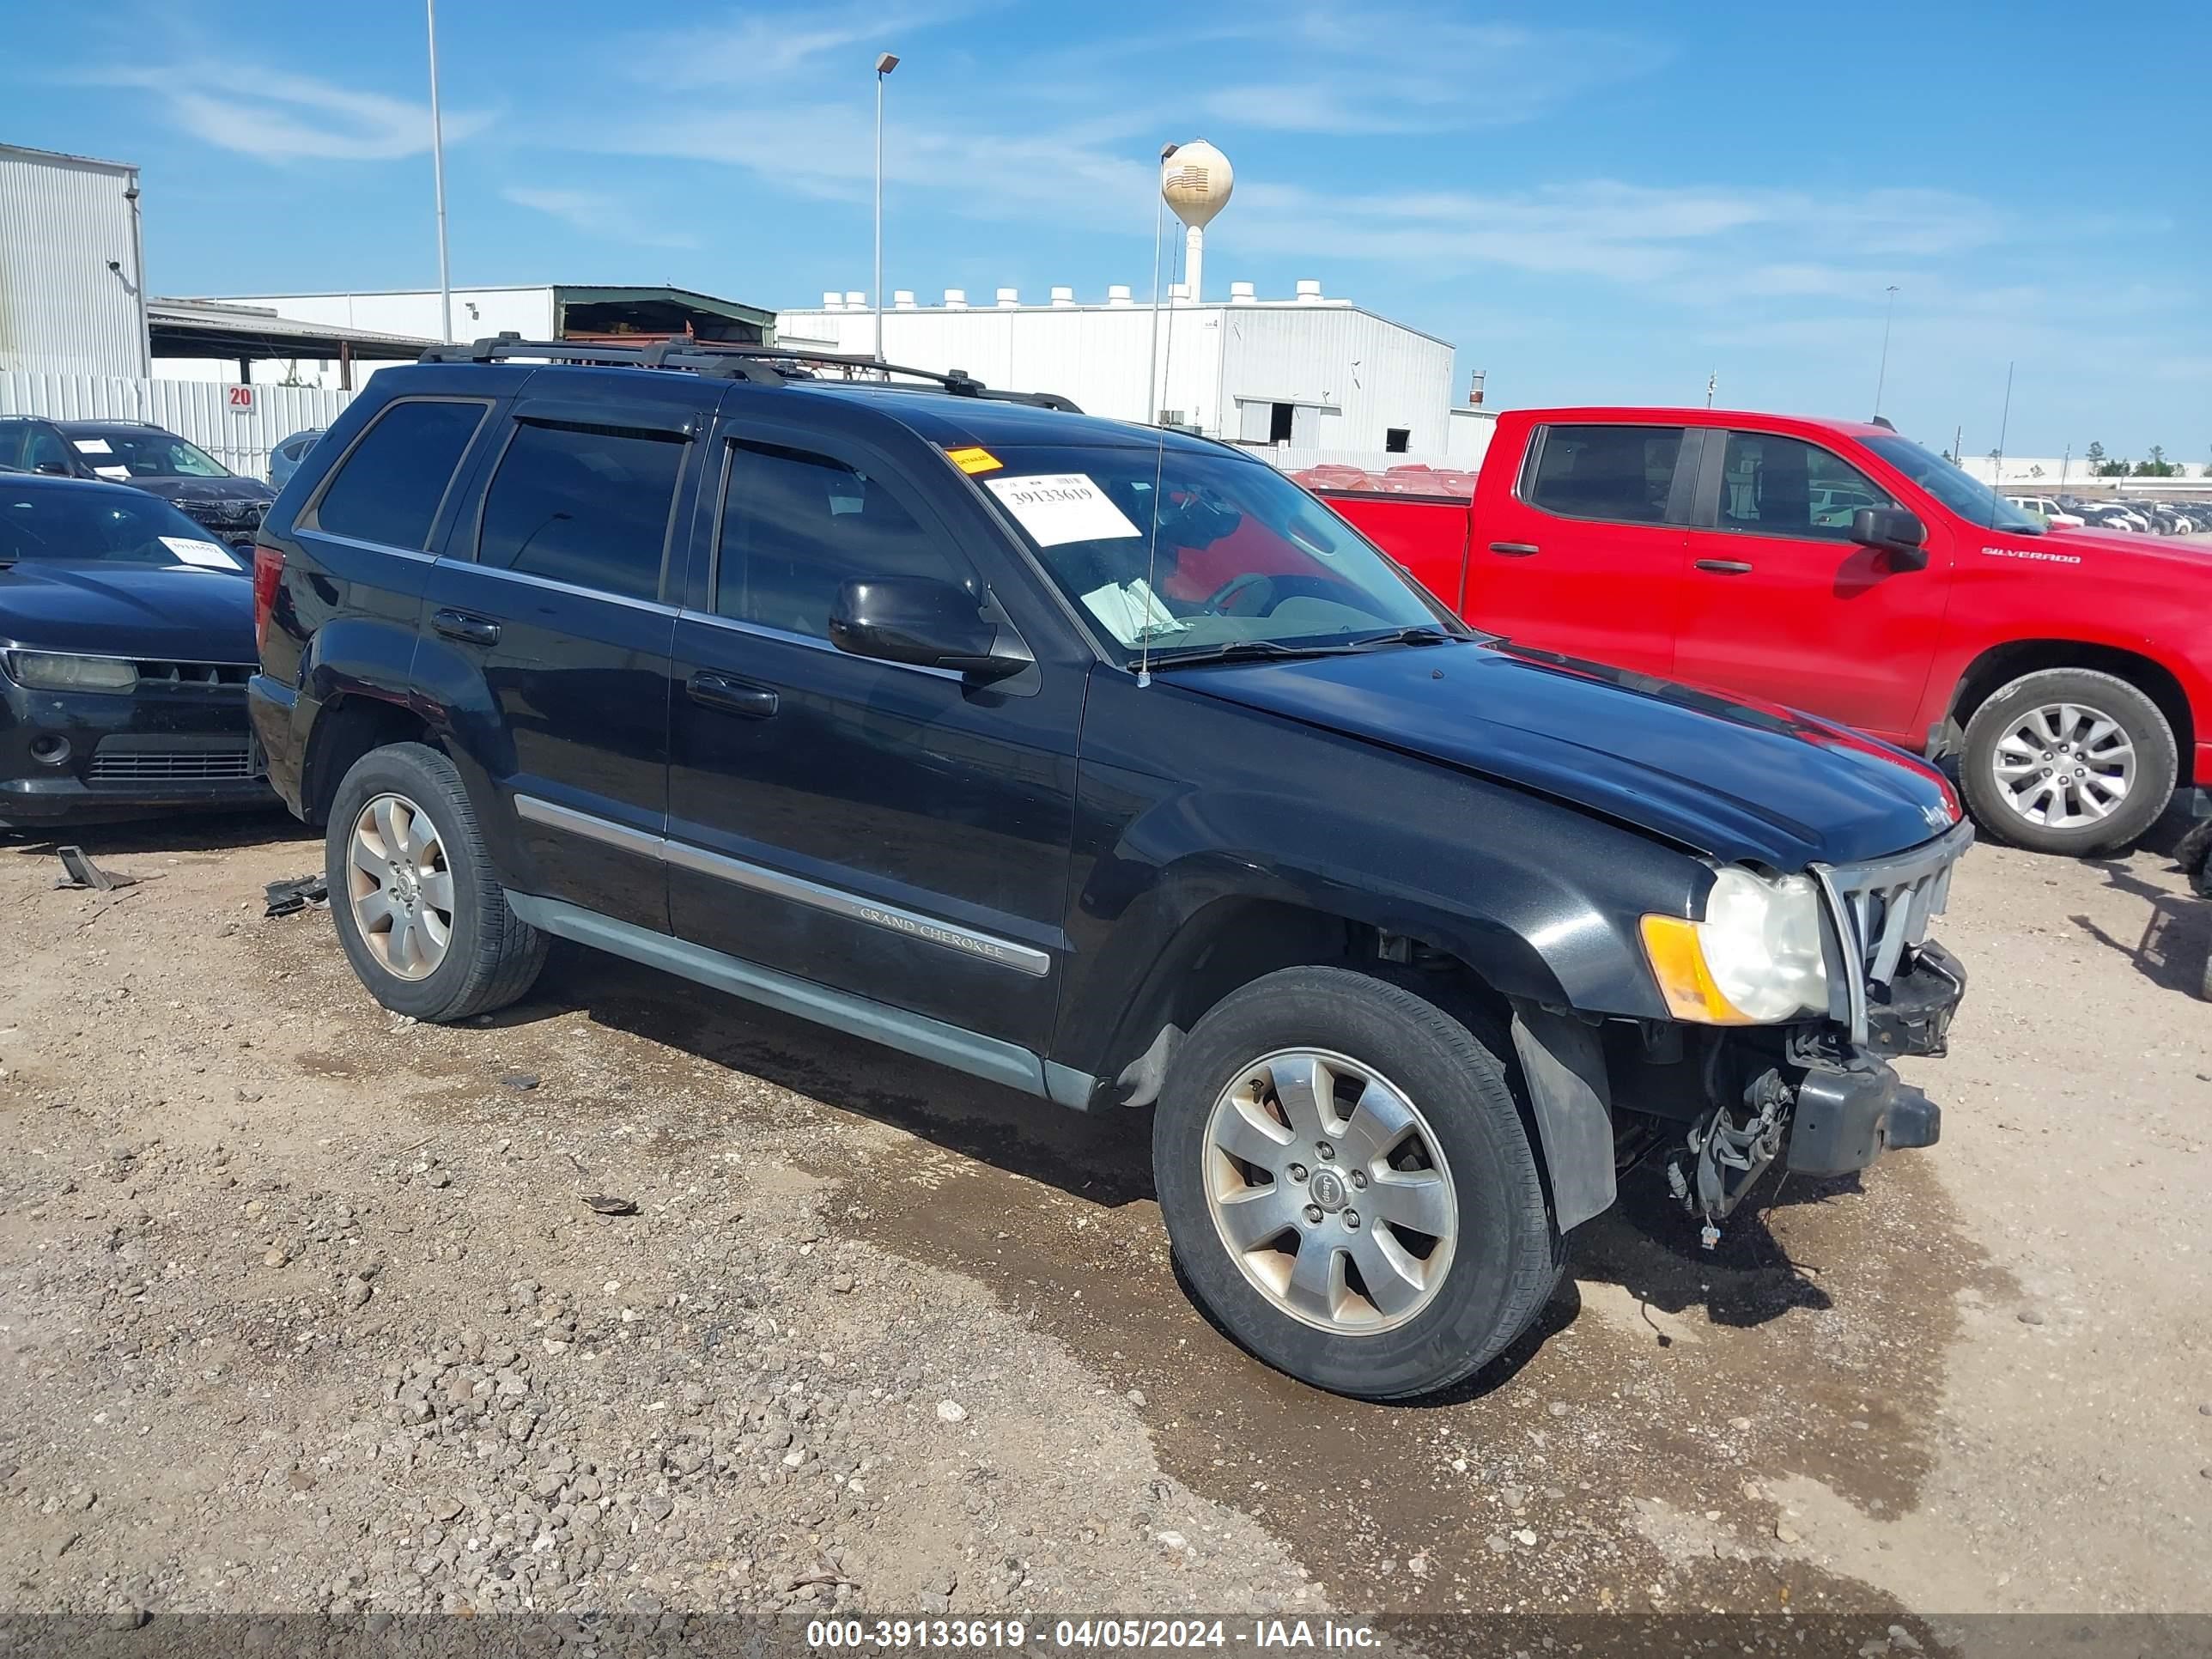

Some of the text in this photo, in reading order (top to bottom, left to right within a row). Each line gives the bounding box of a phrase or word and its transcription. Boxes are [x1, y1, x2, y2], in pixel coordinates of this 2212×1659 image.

[230, 387, 251, 405] 20
[957, 455, 988, 465] DETAILED
[1011, 488, 1092, 505] 39133619
[1981, 547, 2081, 563] SILVERADO
[860, 908, 1005, 958] GRAND CHEROKEE
[1322, 1176, 1333, 1202] Jeep
